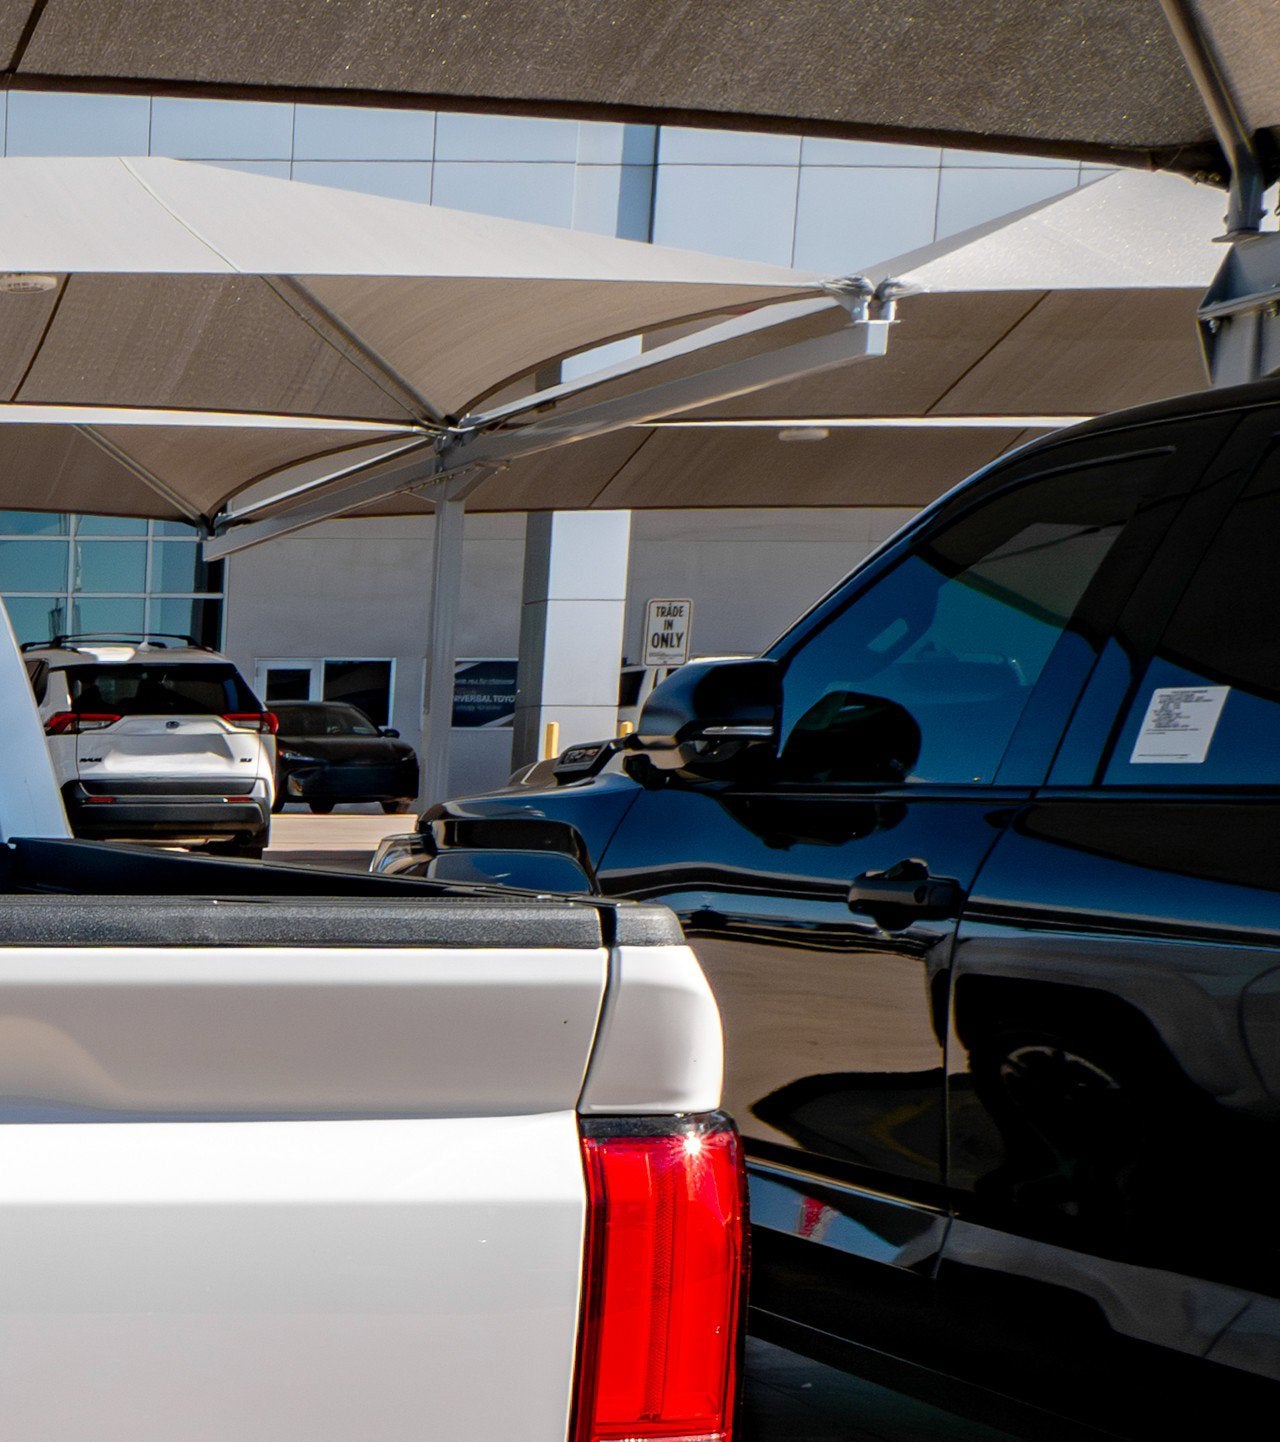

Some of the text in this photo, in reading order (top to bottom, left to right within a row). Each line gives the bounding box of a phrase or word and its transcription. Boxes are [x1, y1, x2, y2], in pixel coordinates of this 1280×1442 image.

[655, 605, 684, 617] TRADE
[663, 619, 674, 631] IN
[651, 632, 684, 648] ONLY
